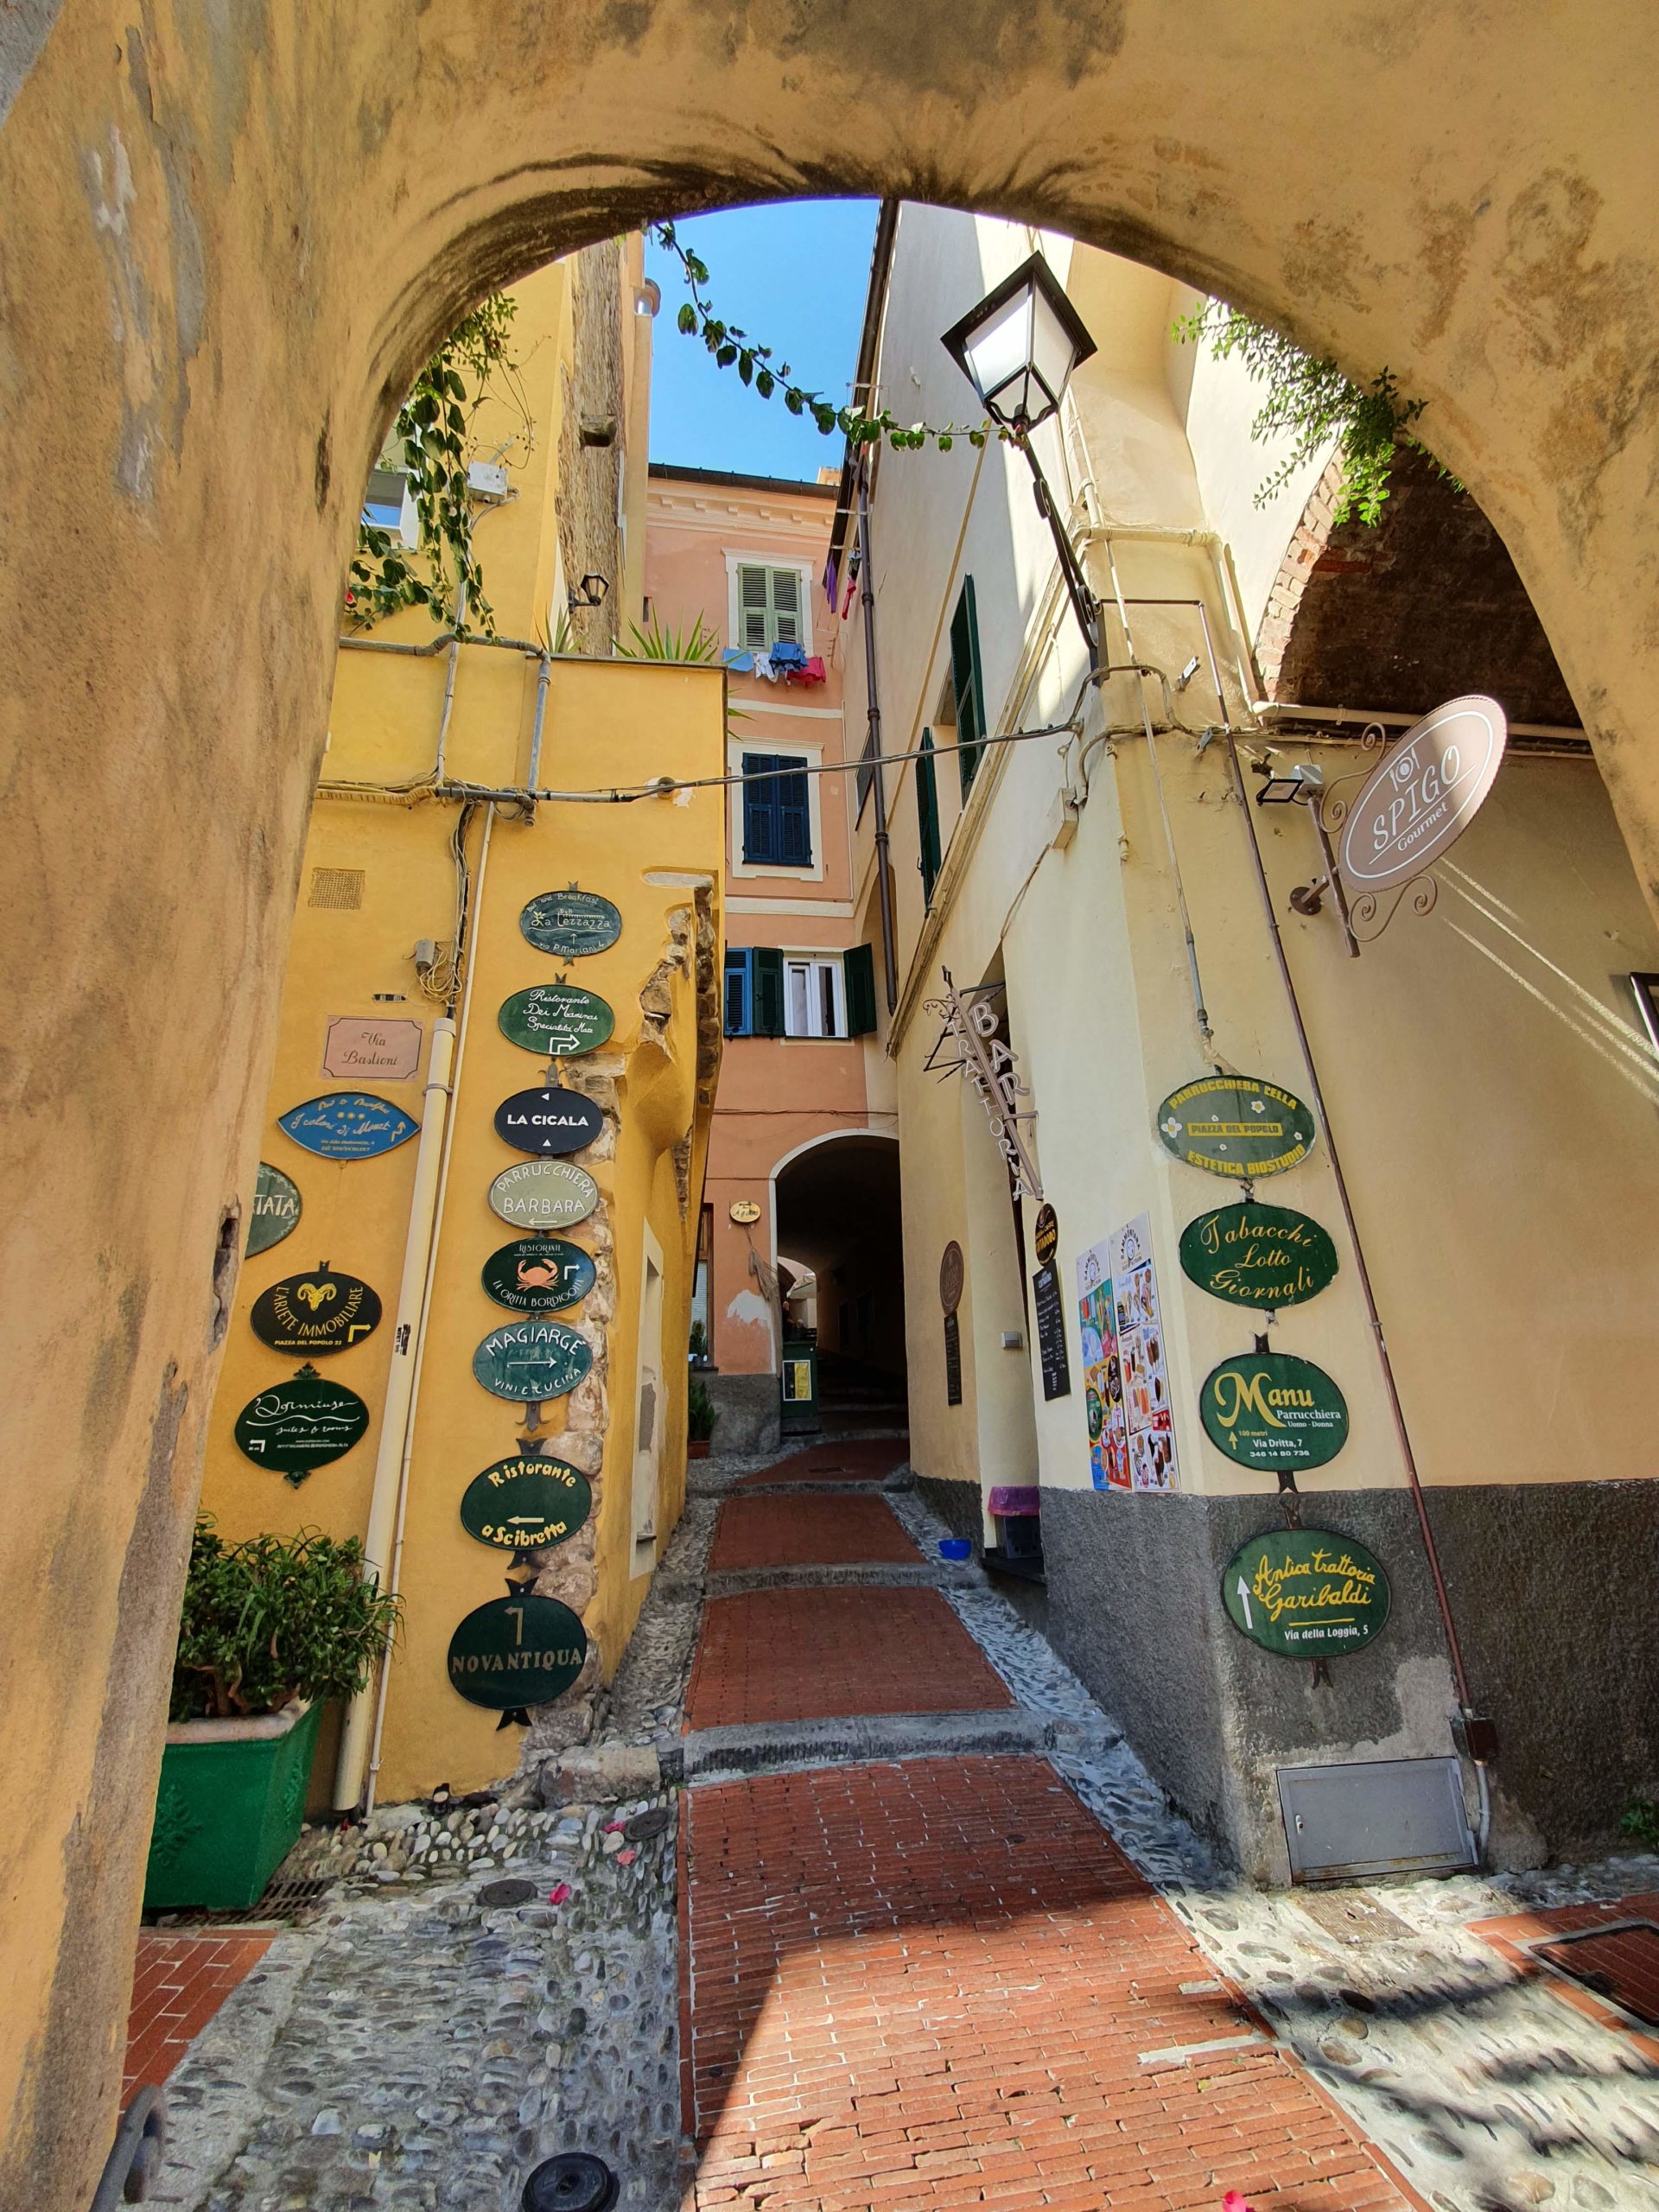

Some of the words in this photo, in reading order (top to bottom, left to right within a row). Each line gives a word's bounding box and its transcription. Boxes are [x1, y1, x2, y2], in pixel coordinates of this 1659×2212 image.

[1373, 745, 1460, 850] SPIGO
[1397, 800, 1449, 852] Gourmet
[557, 893, 600, 904] Breakfast
[531, 918, 552, 926] La
[523, 1003, 550, 1016] Dei
[529, 989, 589, 1004] Ristorante
[361, 1032, 387, 1046] Via
[341, 1050, 398, 1065] Bastioni
[969, 1002, 1030, 1106] BAR
[1169, 1080, 1260, 1110] PARRUCCHIERA
[506, 1115, 528, 1125] LA
[531, 1115, 589, 1127] CICALA
[1192, 1125, 1224, 1134] PIAZZA
[1225, 1125, 1242, 1134] DEL
[1243, 1125, 1280, 1134] POPOLO
[1187, 1150, 1245, 1175] ESTETICA
[1247, 1143, 1306, 1175] BIOSTUDIO
[496, 1164, 594, 1198] PARRUCCHIERA
[503, 1198, 585, 1215] BARBARA
[1200, 1214, 1318, 1255] Tabacchi
[1235, 1243, 1293, 1268] Lotto
[1210, 1266, 1314, 1299] Giornali
[273, 1286, 299, 1332] L'ARIETE
[297, 1286, 364, 1338] IMMOBILIARE
[494, 1377, 518, 1393] VINI
[521, 1386, 529, 1395] E
[531, 1368, 582, 1395] CUCINA
[1214, 1372, 1315, 1427] Manu
[1276, 1409, 1342, 1420] Parrucchiera
[1253, 1439, 1268, 1448] Via
[1268, 1439, 1297, 1449] Dritta,
[1297, 1439, 1303, 1447] 7
[487, 1461, 577, 1488] Ristorante
[481, 1524, 494, 1538] a
[493, 1521, 568, 1547] Scibretta
[1252, 1554, 1313, 1596] Antica
[1258, 1579, 1372, 1623] Garibaldi
[1284, 1629, 1300, 1641] Via
[1301, 1628, 1325, 1639] della
[1327, 1626, 1361, 1638] Loggia,
[1363, 1624, 1369, 1635] 5
[451, 1647, 583, 1674] NOVANTIQUA
